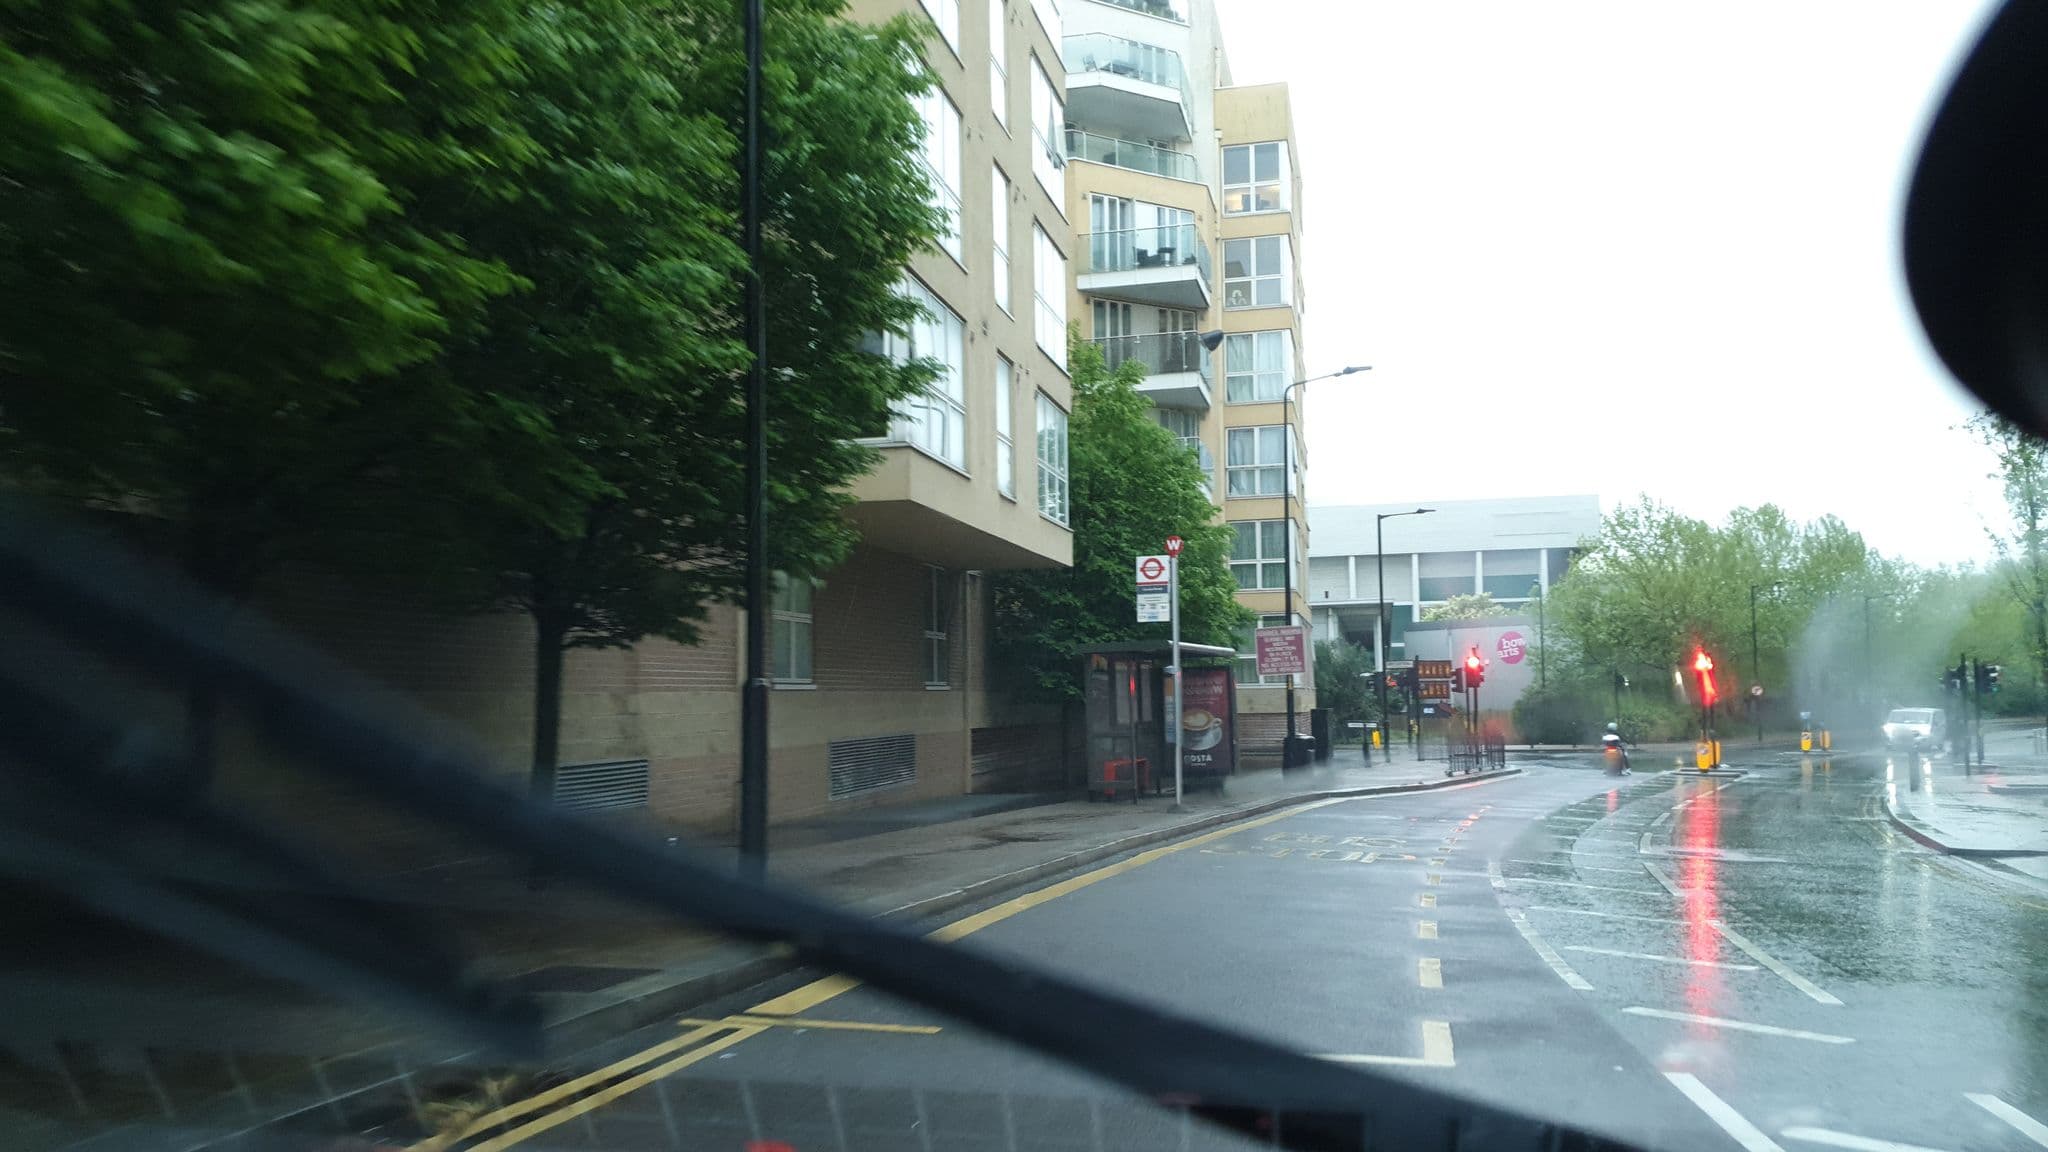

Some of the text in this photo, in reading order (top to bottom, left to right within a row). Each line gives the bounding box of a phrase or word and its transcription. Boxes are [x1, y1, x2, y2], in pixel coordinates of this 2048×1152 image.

[1166, 539, 1181, 550] W
[1501, 638, 1527, 649] bow
[1496, 648, 1520, 657] arts
